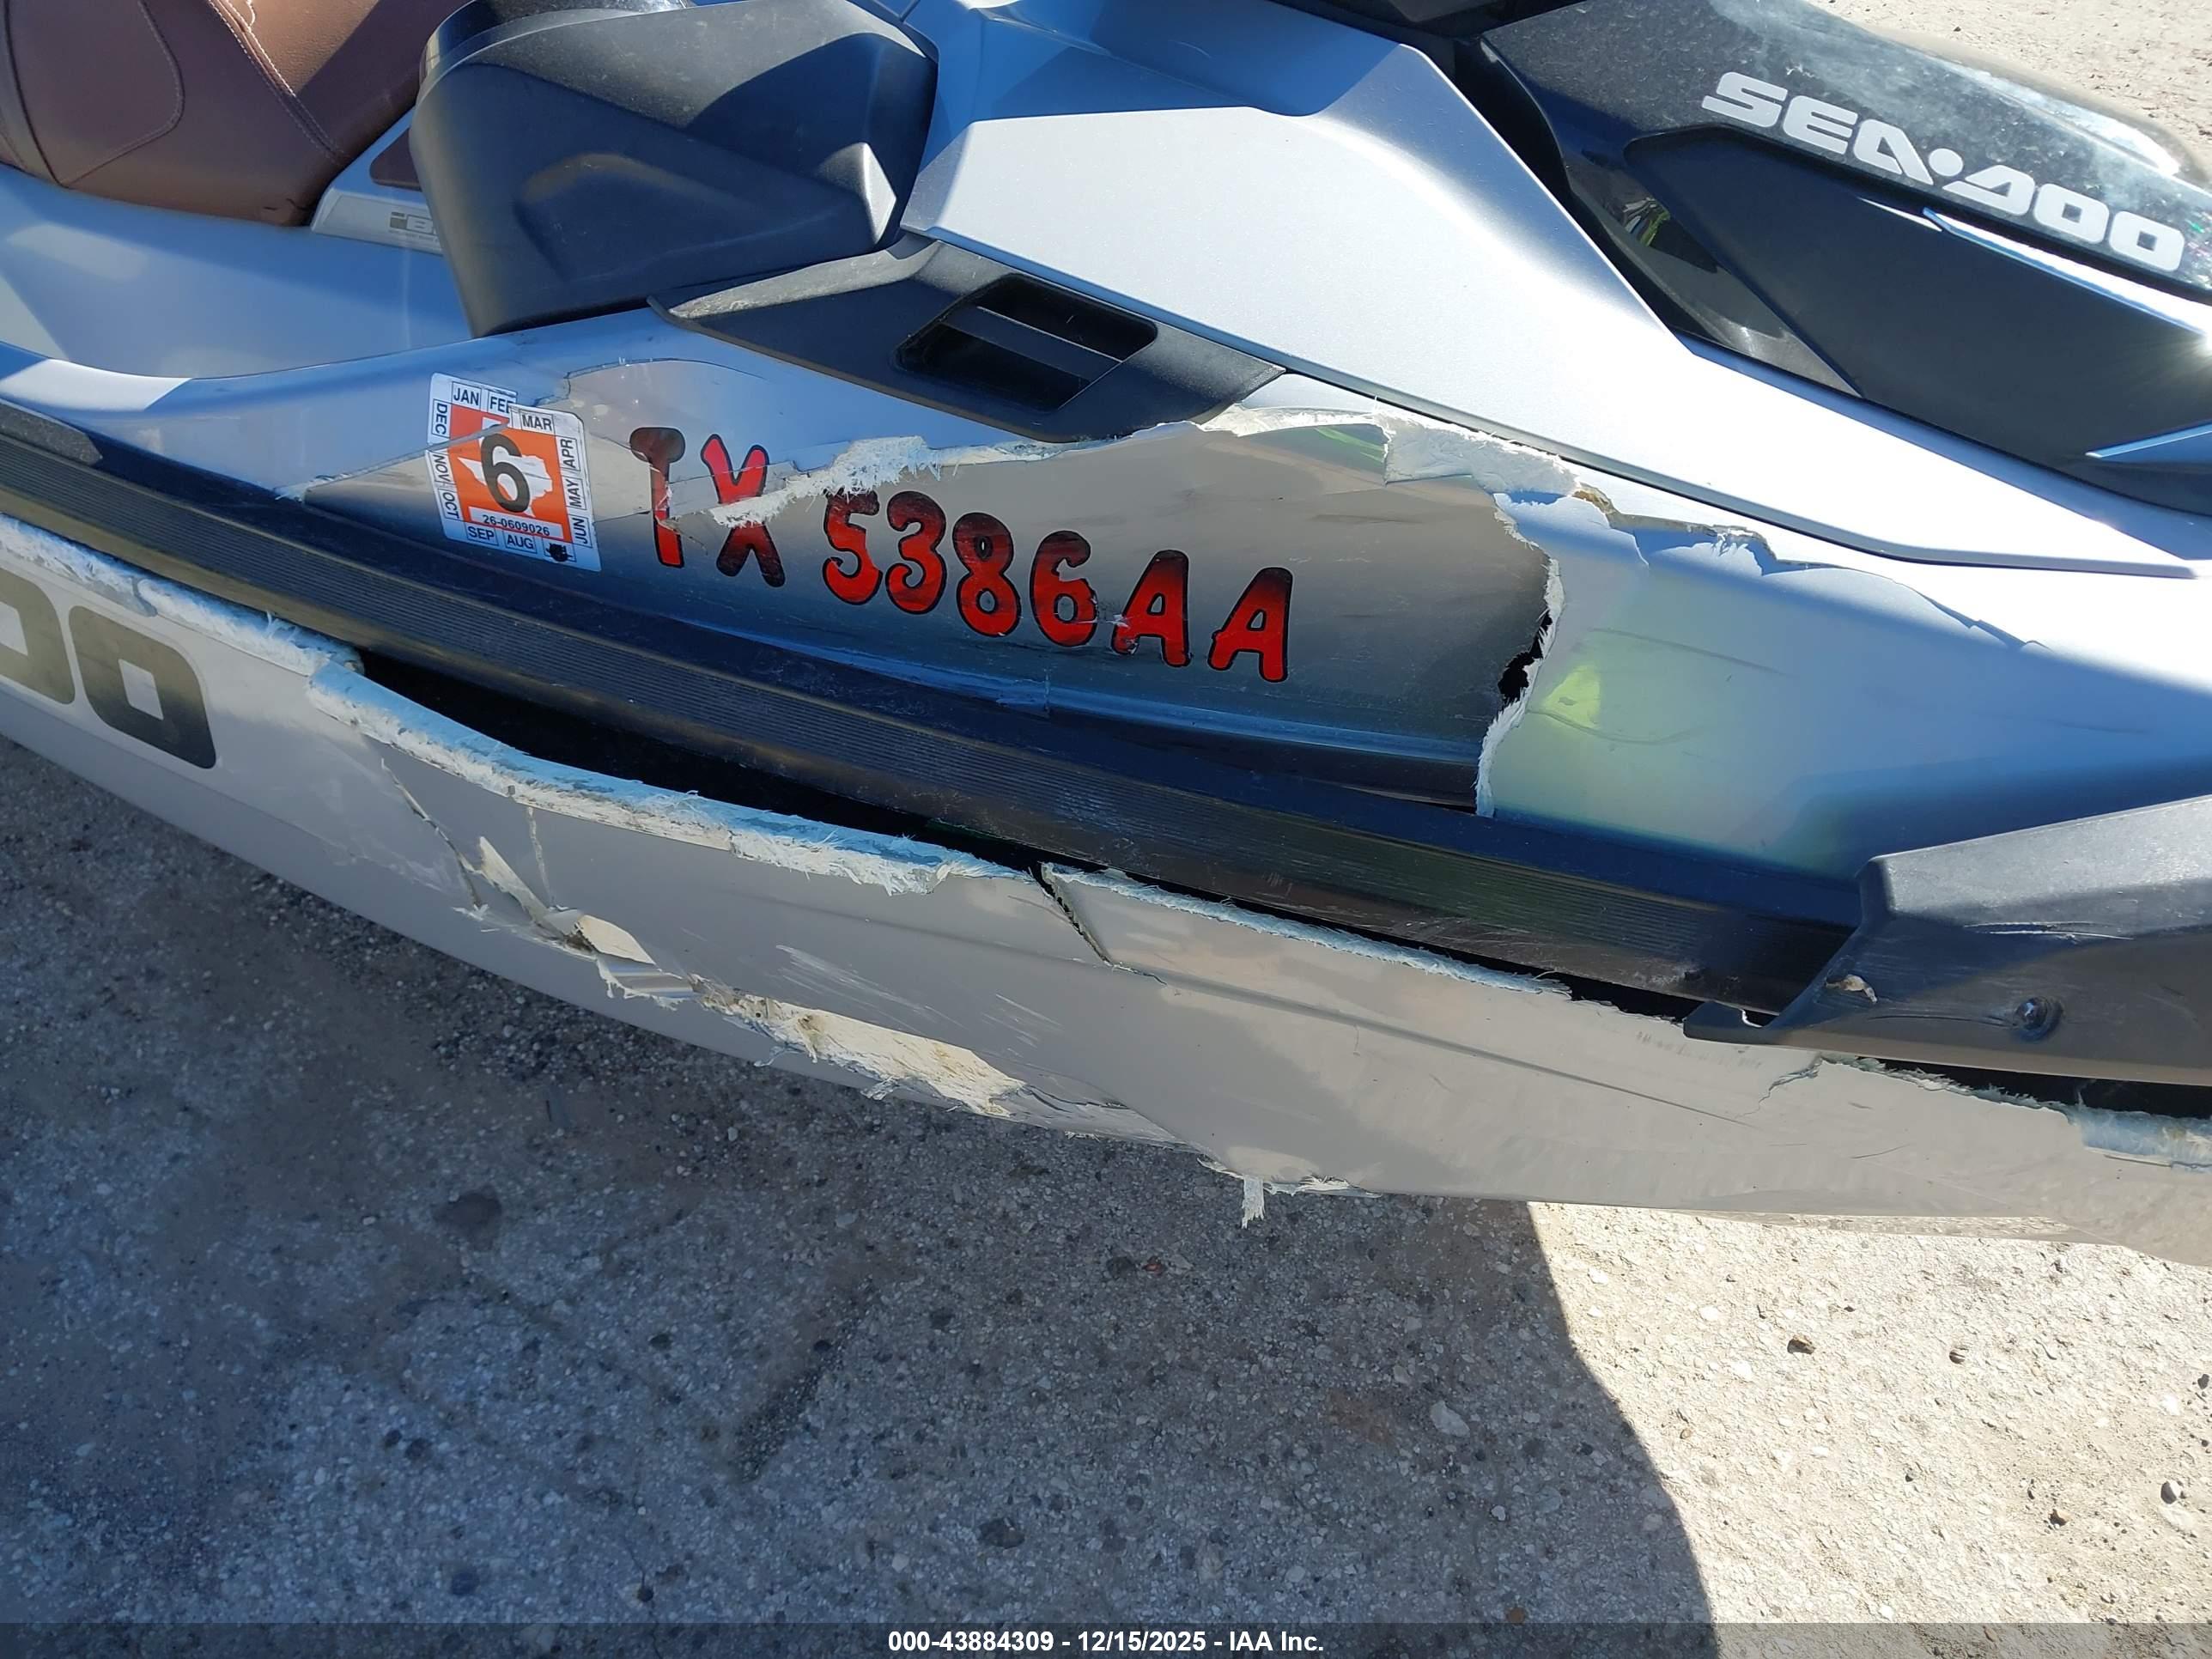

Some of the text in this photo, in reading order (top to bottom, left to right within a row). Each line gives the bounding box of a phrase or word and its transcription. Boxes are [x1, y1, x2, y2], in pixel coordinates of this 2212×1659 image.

[453, 387, 479, 405] JAN
[434, 403, 447, 435] DEC
[521, 413, 552, 431] MAR
[432, 454, 451, 483] NOV
[561, 439, 578, 469] APR
[480, 433, 531, 514] 6
[441, 491, 459, 520] OCT
[566, 478, 582, 508] MAY
[629, 426, 787, 587] TX
[467, 526, 495, 542] SEP
[483, 514, 550, 537] 26-0609026
[572, 517, 588, 544] JUN
[507, 535, 534, 550] AUG
